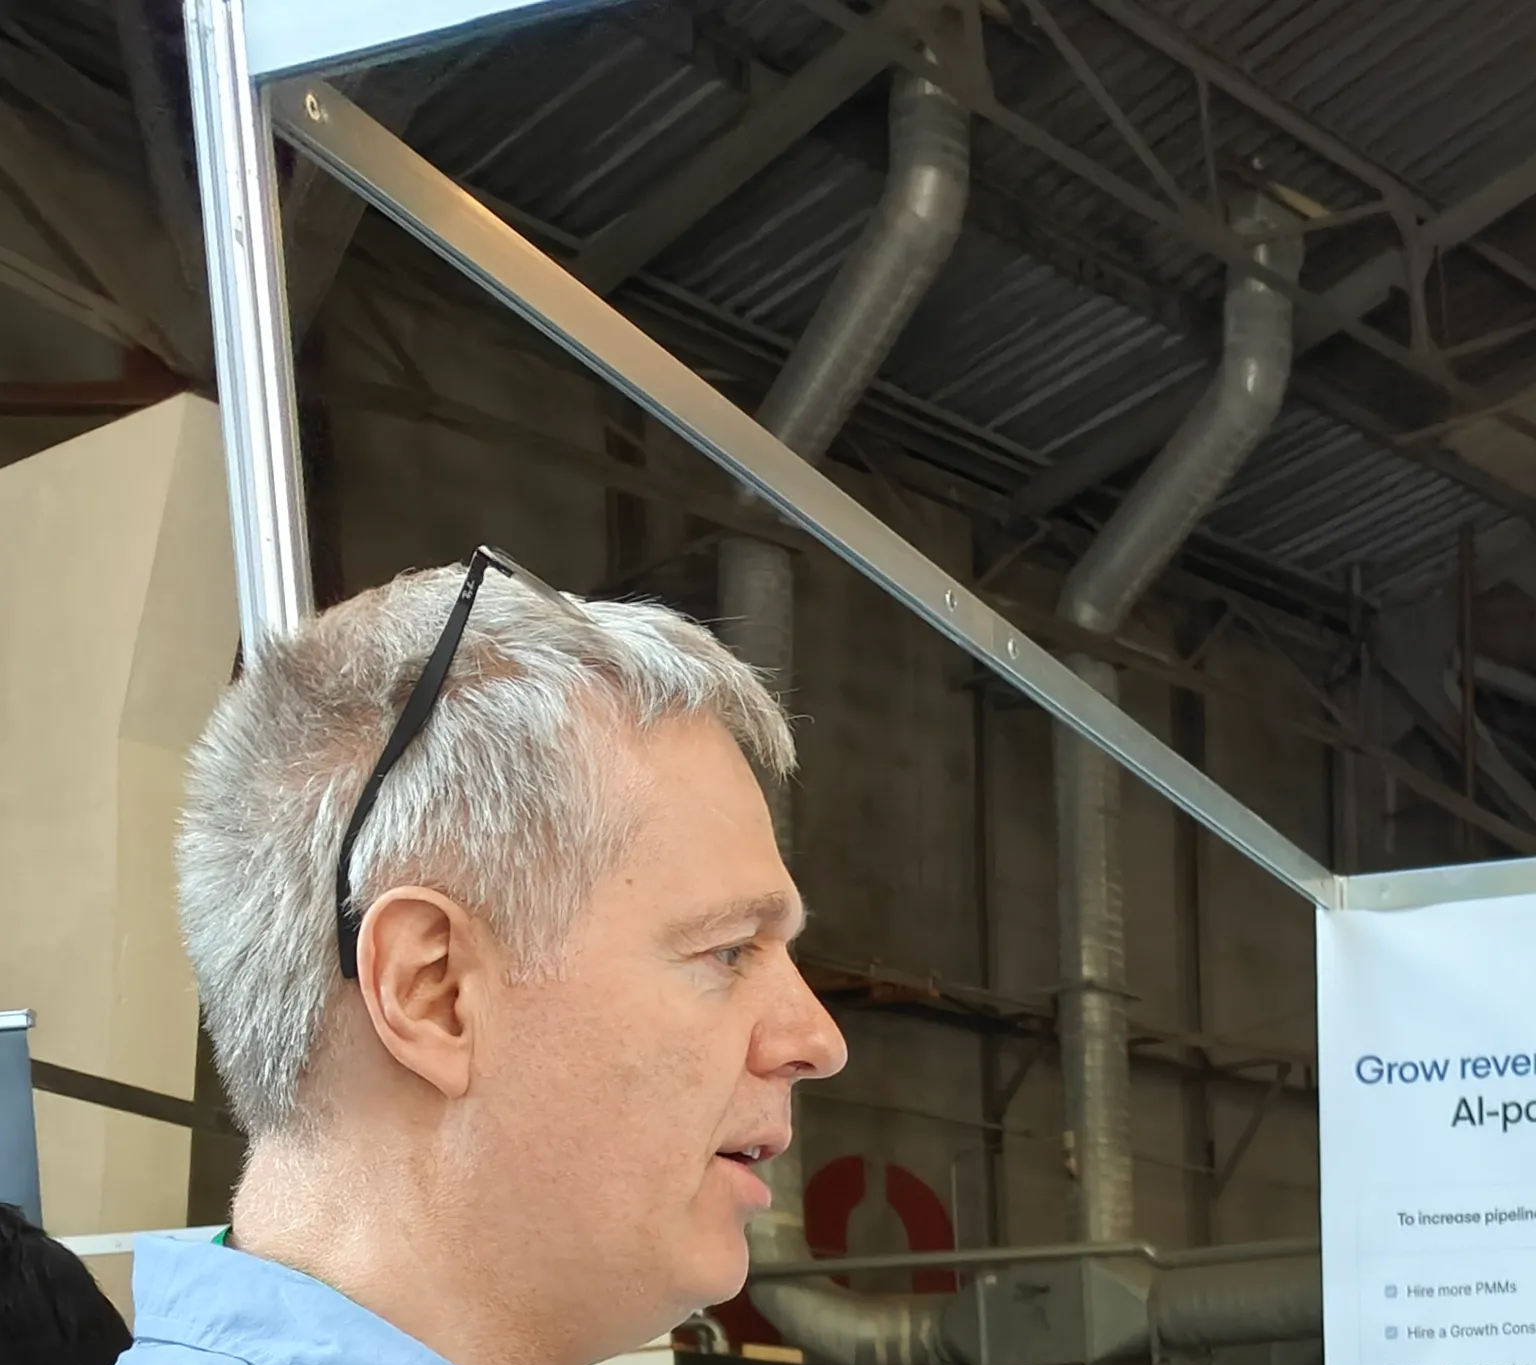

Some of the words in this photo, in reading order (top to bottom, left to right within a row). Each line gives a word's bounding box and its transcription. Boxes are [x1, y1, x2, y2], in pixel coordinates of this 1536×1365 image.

[1356, 1055, 1450, 1084] Grow
[1397, 1211, 1415, 1227] To
[1418, 1209, 1481, 1226] increase
[1407, 1285, 1434, 1298] Hire
[1438, 1283, 1472, 1297] more
[1475, 1280, 1517, 1295] PMMs
[1407, 1326, 1434, 1340] Hire
[1438, 1328, 1447, 1339] a
[1450, 1322, 1498, 1338] Growth
